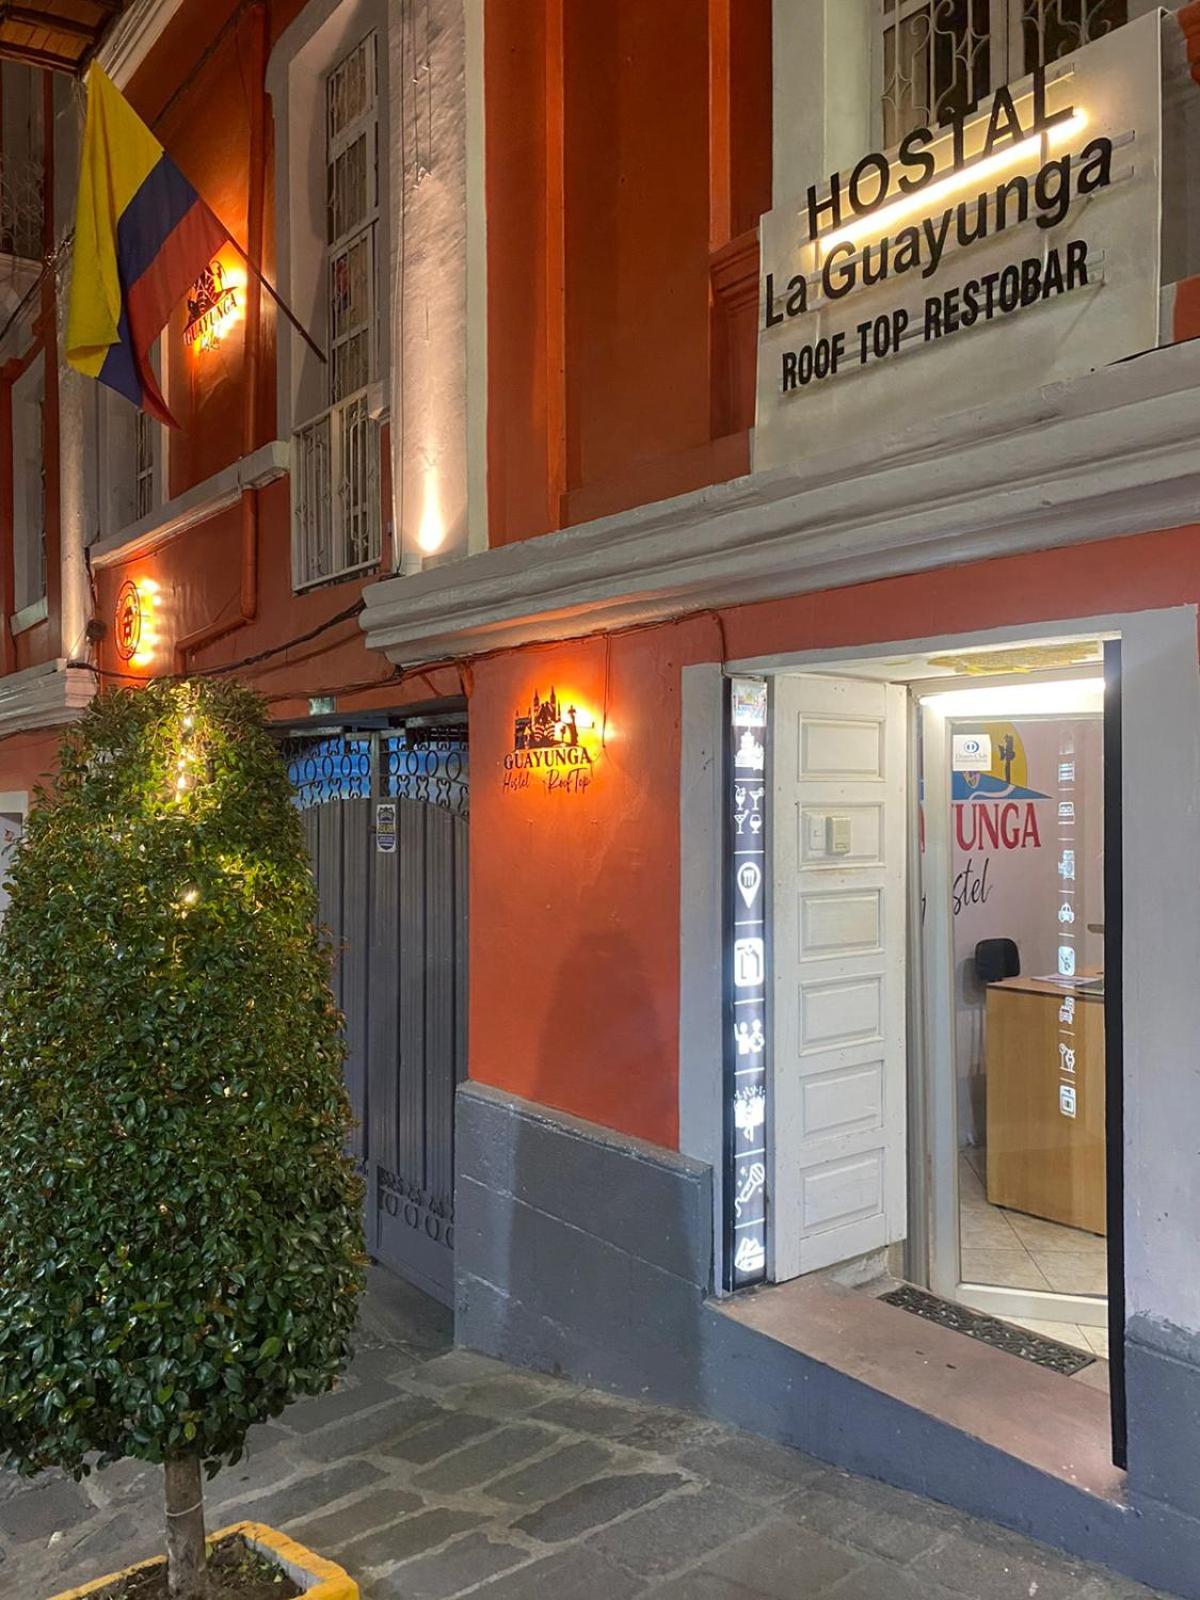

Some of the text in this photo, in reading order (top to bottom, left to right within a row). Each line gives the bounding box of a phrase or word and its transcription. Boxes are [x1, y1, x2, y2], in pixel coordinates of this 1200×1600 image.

[806, 66, 1075, 241] HOSTAL
[765, 136, 1112, 328] La Guayunga
[782, 239, 1089, 392] ROOF TOP RESTOBAR
[503, 747, 592, 769] GUAYUNGA
[951, 802, 1041, 851] UNGA
[953, 857, 993, 915] stel
